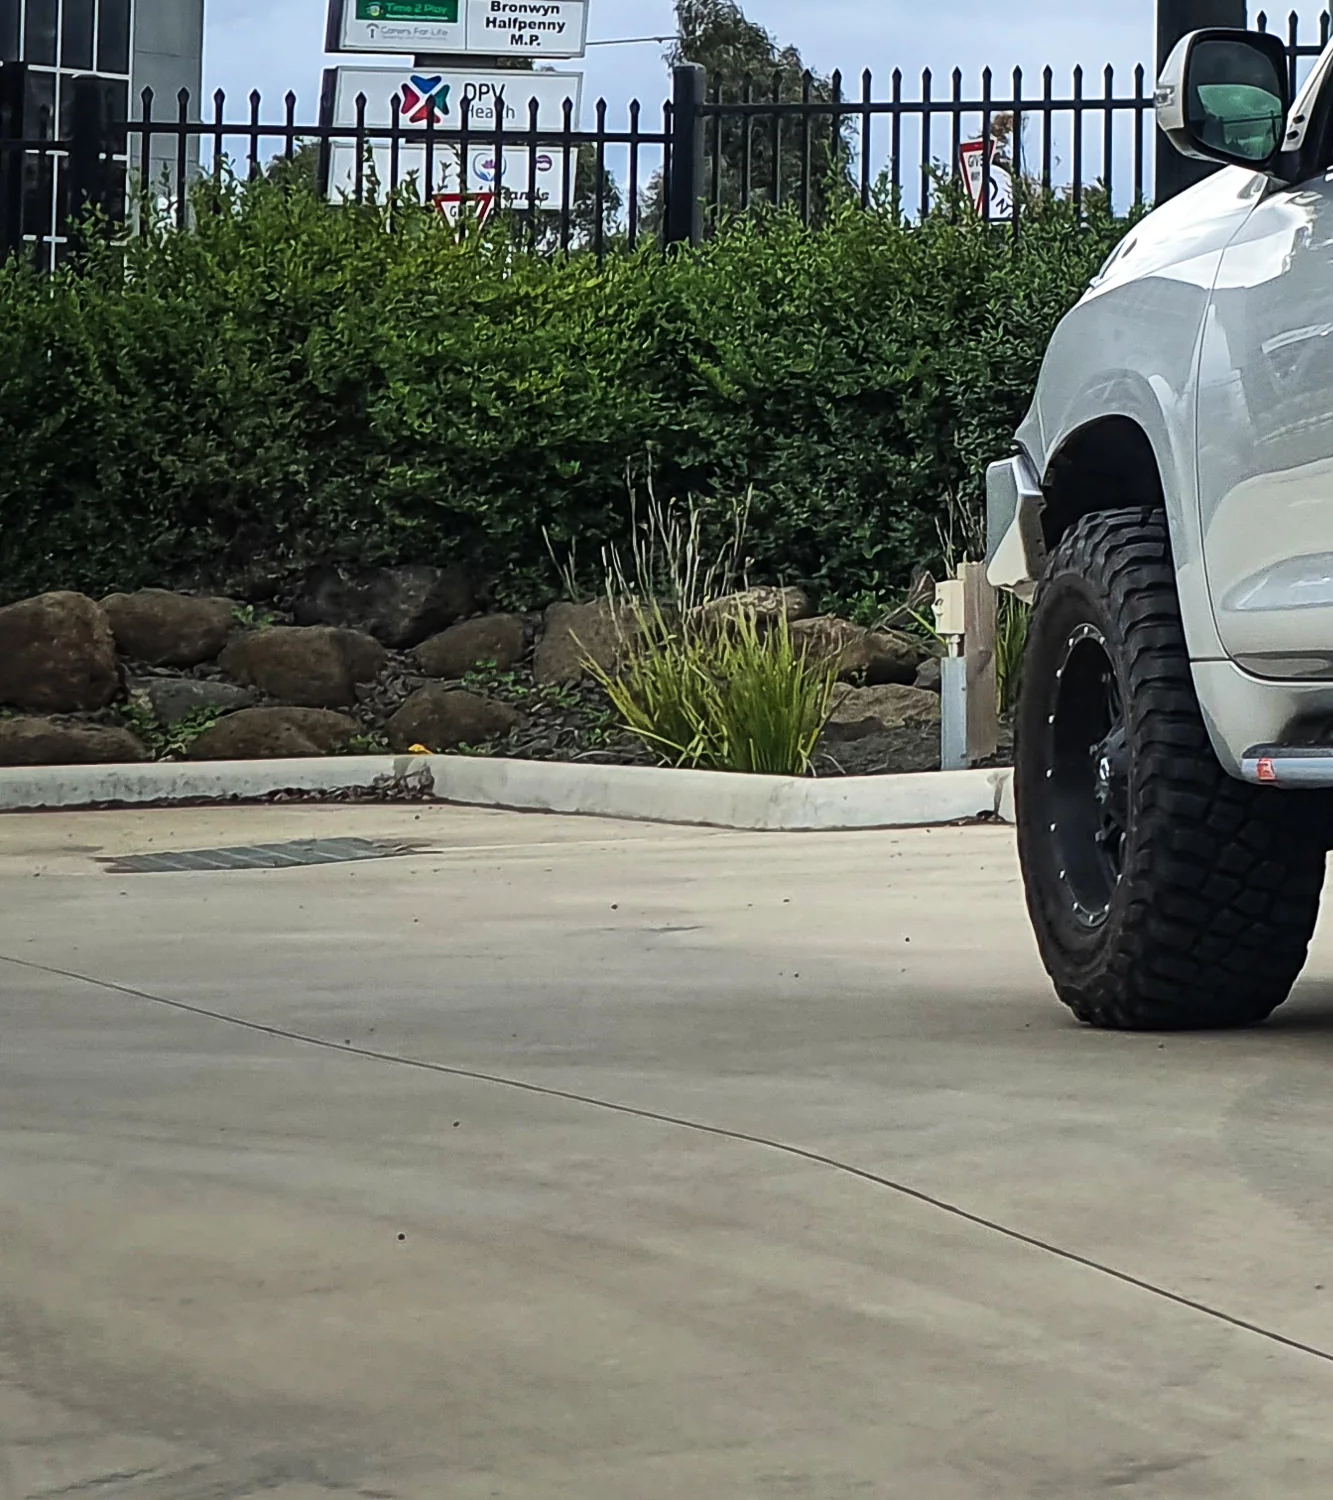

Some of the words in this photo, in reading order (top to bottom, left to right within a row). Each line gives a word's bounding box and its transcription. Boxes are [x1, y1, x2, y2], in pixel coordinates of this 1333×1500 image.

[491, 0, 560, 15] Bronwyn
[485, 16, 566, 33] Halfpenny
[510, 34, 541, 47] M.P.
[464, 83, 505, 102] DPV
